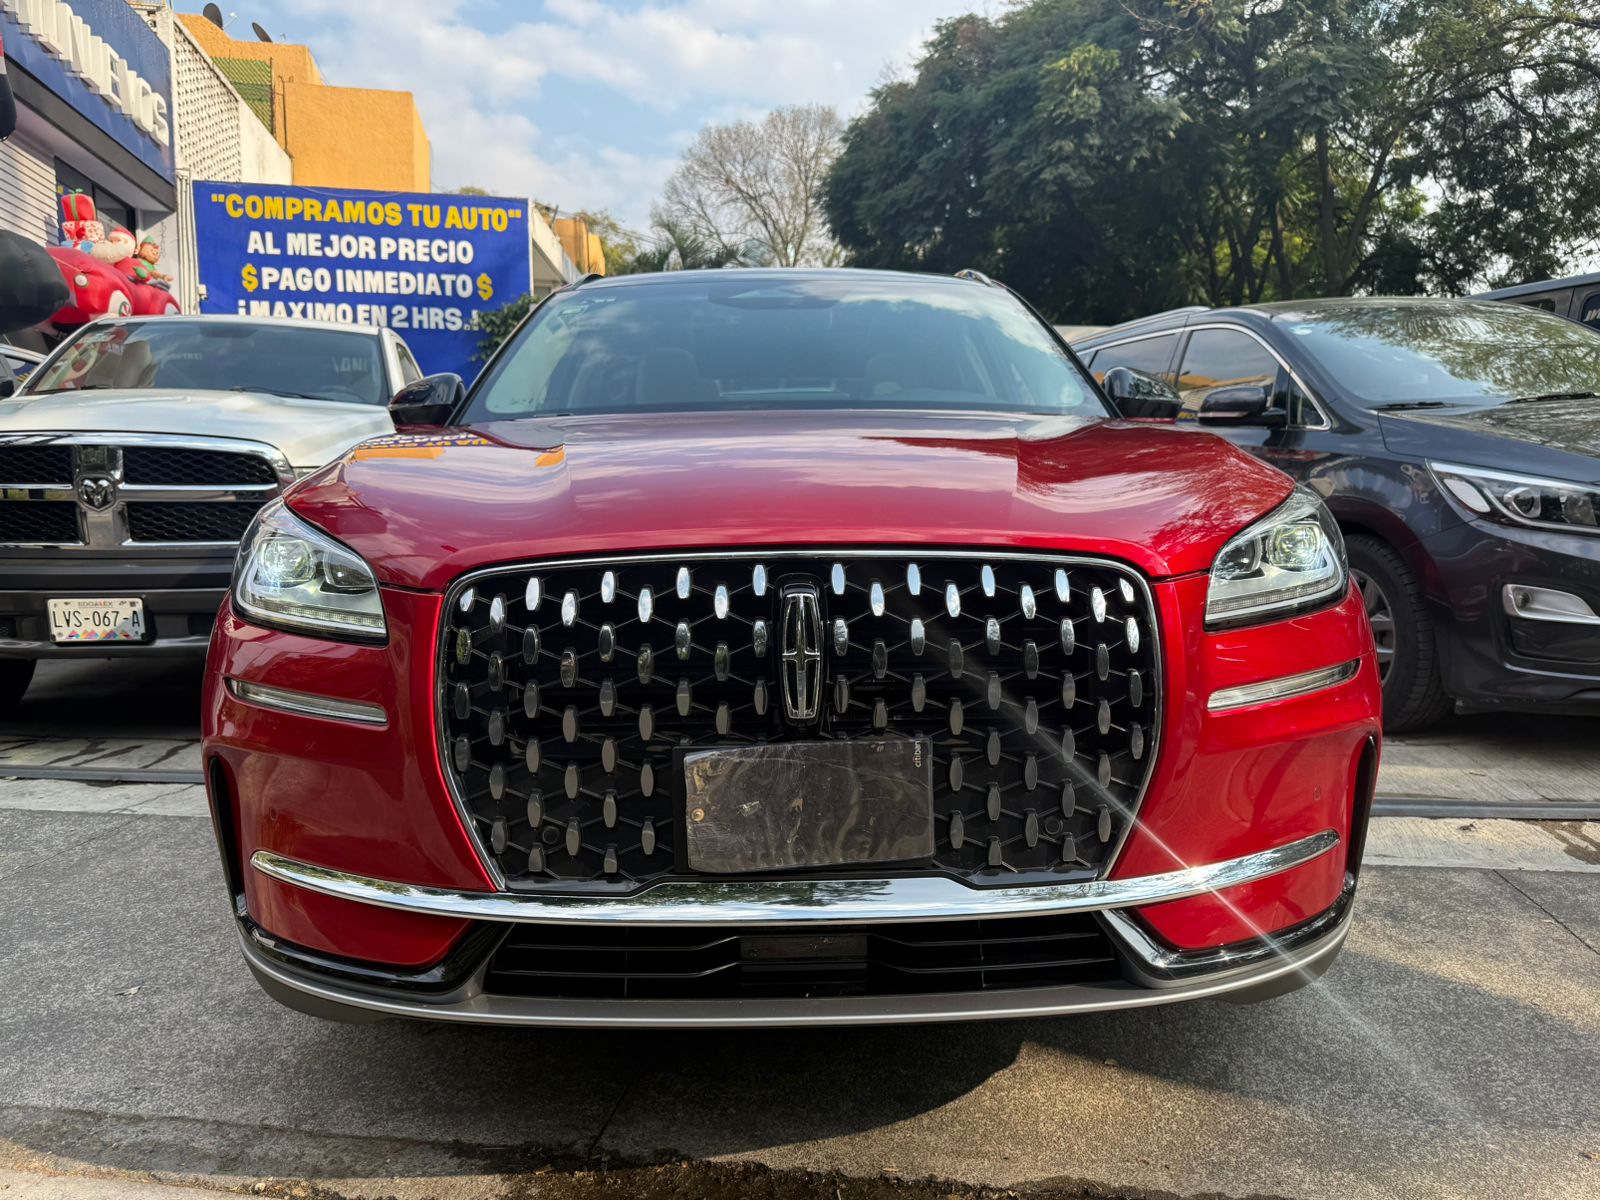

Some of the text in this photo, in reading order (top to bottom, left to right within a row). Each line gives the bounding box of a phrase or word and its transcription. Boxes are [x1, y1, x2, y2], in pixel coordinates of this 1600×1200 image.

[211, 193, 521, 232] "COMPRAMOS TU AUTO"
[247, 231, 474, 264] AL MEJOR PRECIO
[261, 267, 331, 292] PAGO
[336, 269, 473, 298] INMEDIATO
[357, 304, 387, 327] EN
[391, 305, 408, 328] 2
[53, 610, 140, 627] LVS-067-A
